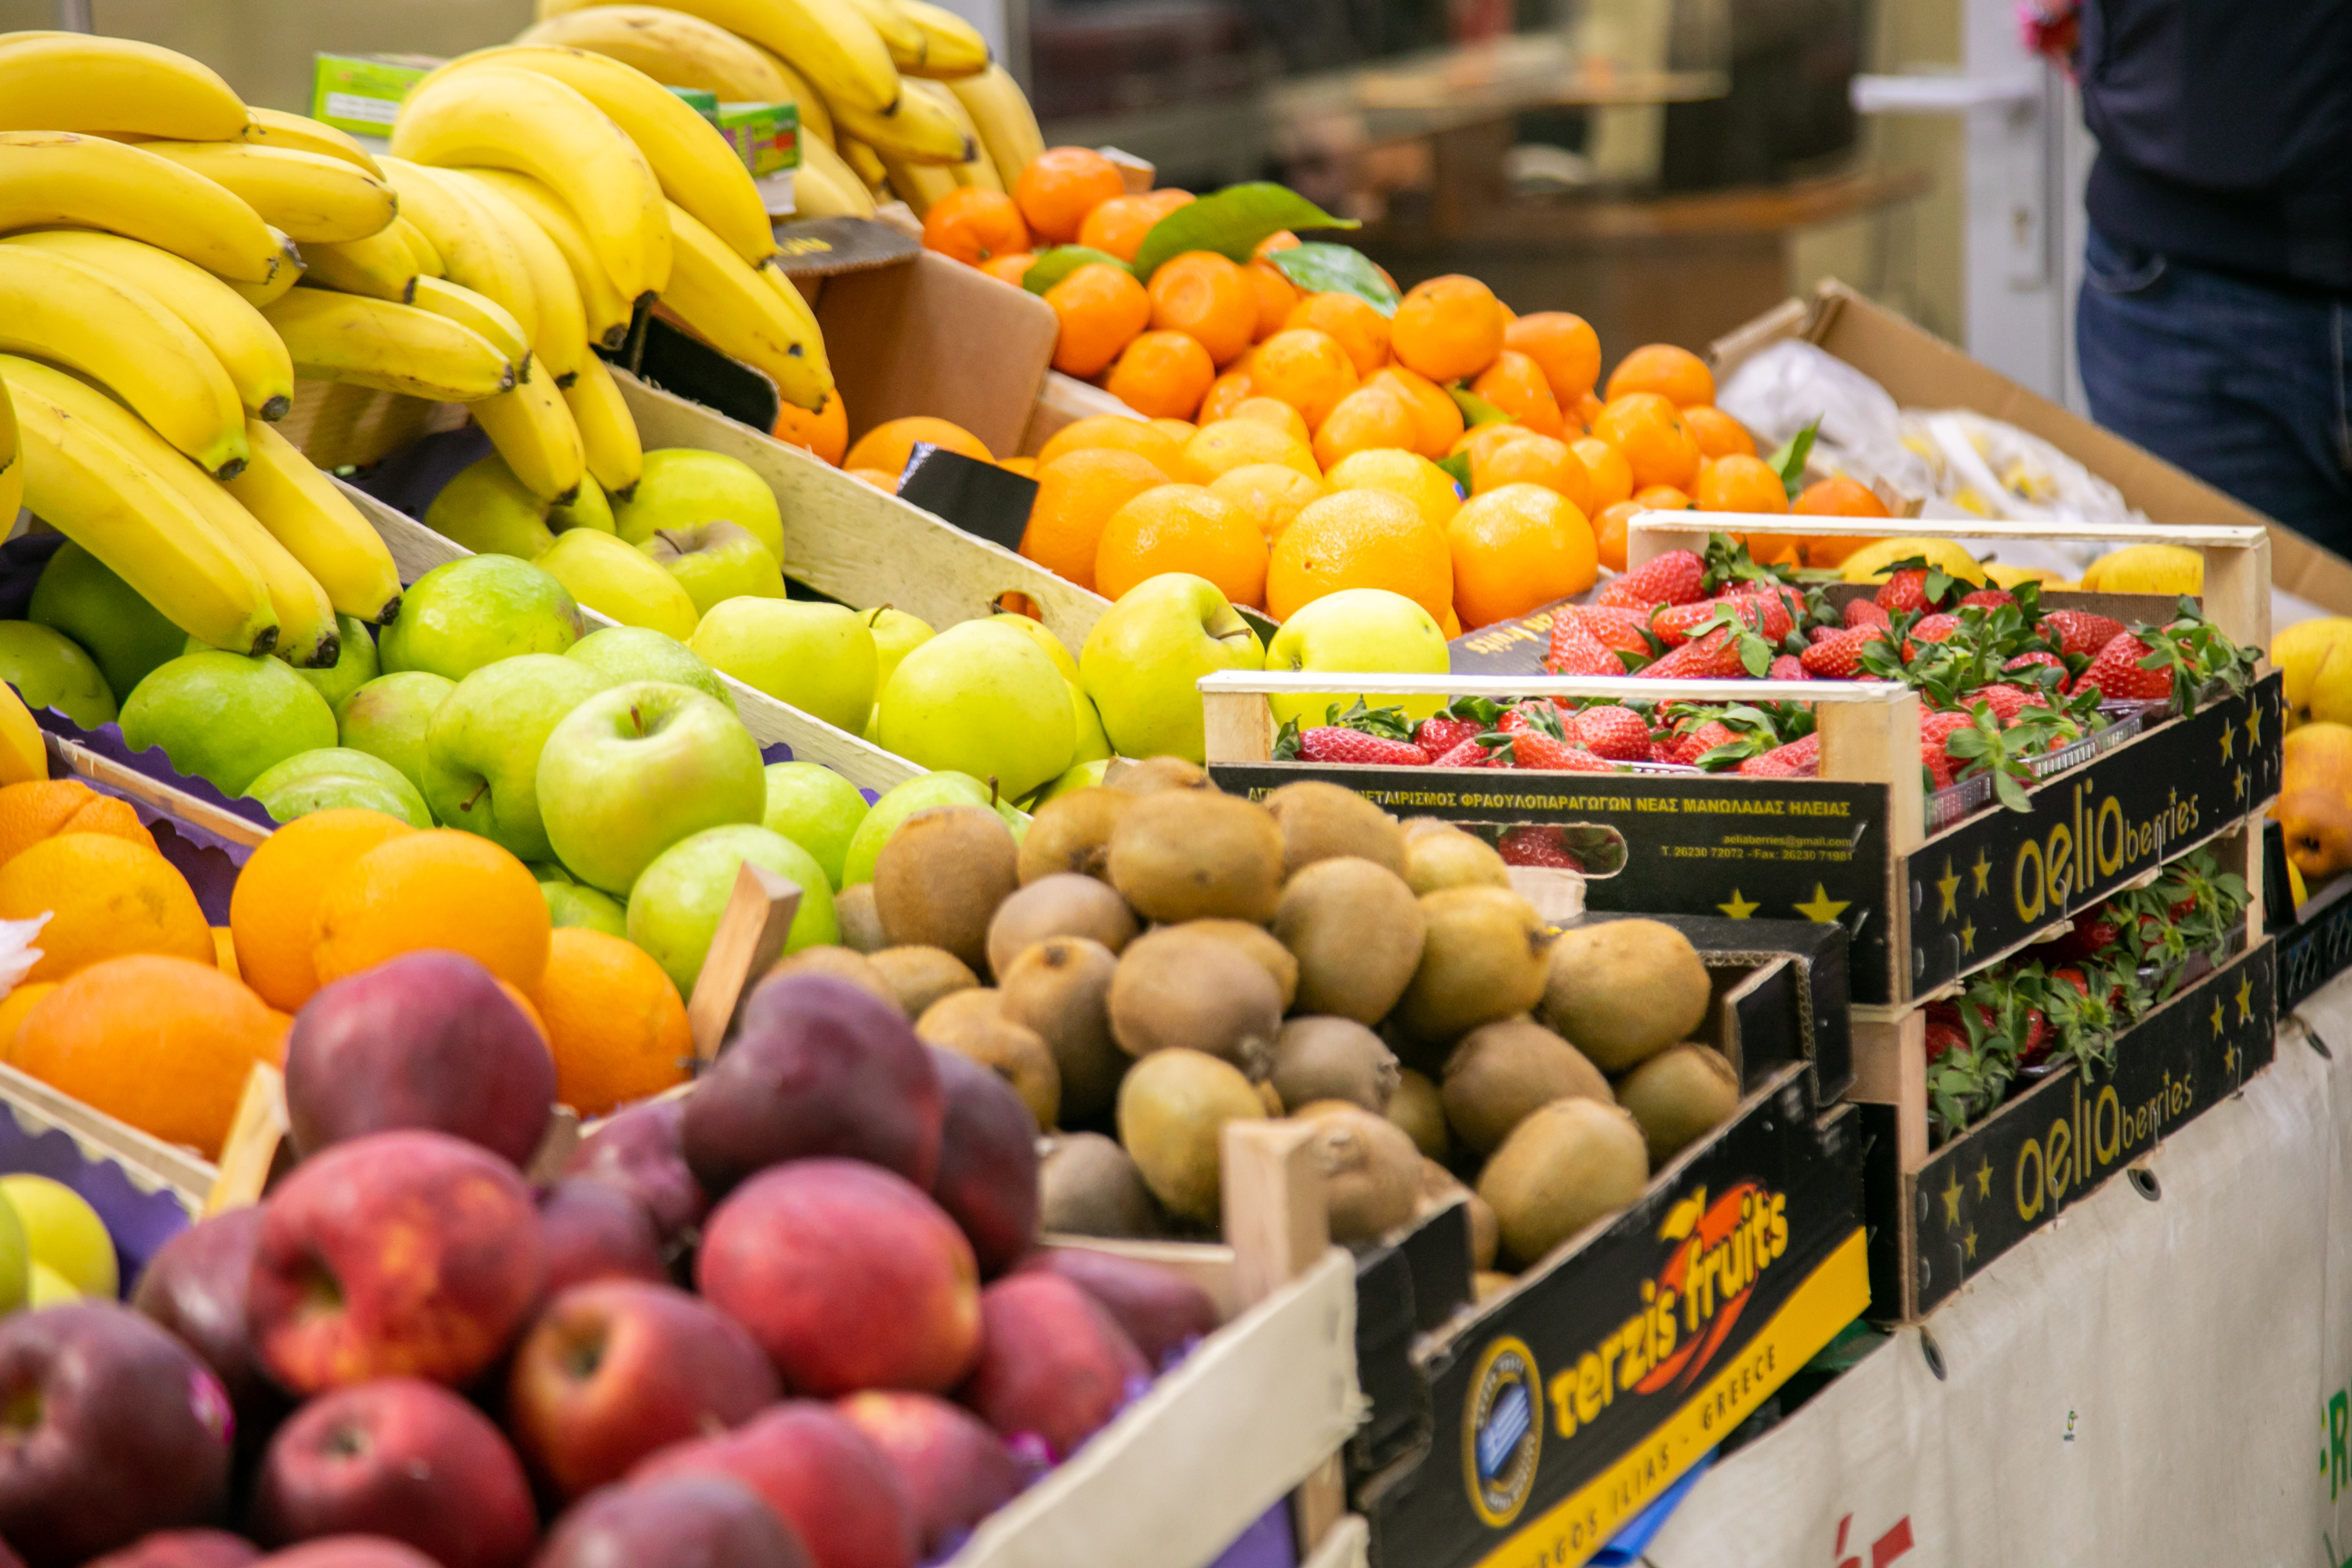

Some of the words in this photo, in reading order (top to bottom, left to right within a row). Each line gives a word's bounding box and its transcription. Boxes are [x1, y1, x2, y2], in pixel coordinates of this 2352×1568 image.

[1635, 798, 1679, 812] ΝΕΑΣ
[1683, 799, 1785, 815] ΜΑΝΩΛΑΔΑΣ
[1790, 801, 1851, 816] ΗΛΕΙΑΣ
[1674, 846, 1708, 857] 26230
[1711, 847, 1744, 858] 72072
[1754, 849, 1779, 859] Fax:
[1782, 850, 1816, 861] 26230
[1818, 851, 1853, 862] 71981
[1548, 1278, 1678, 1439] terzis
[1685, 1191, 1789, 1332] fruits
[1522, 1508, 1599, 1568] RGOS
[1701, 1343, 1777, 1431] GREECE
